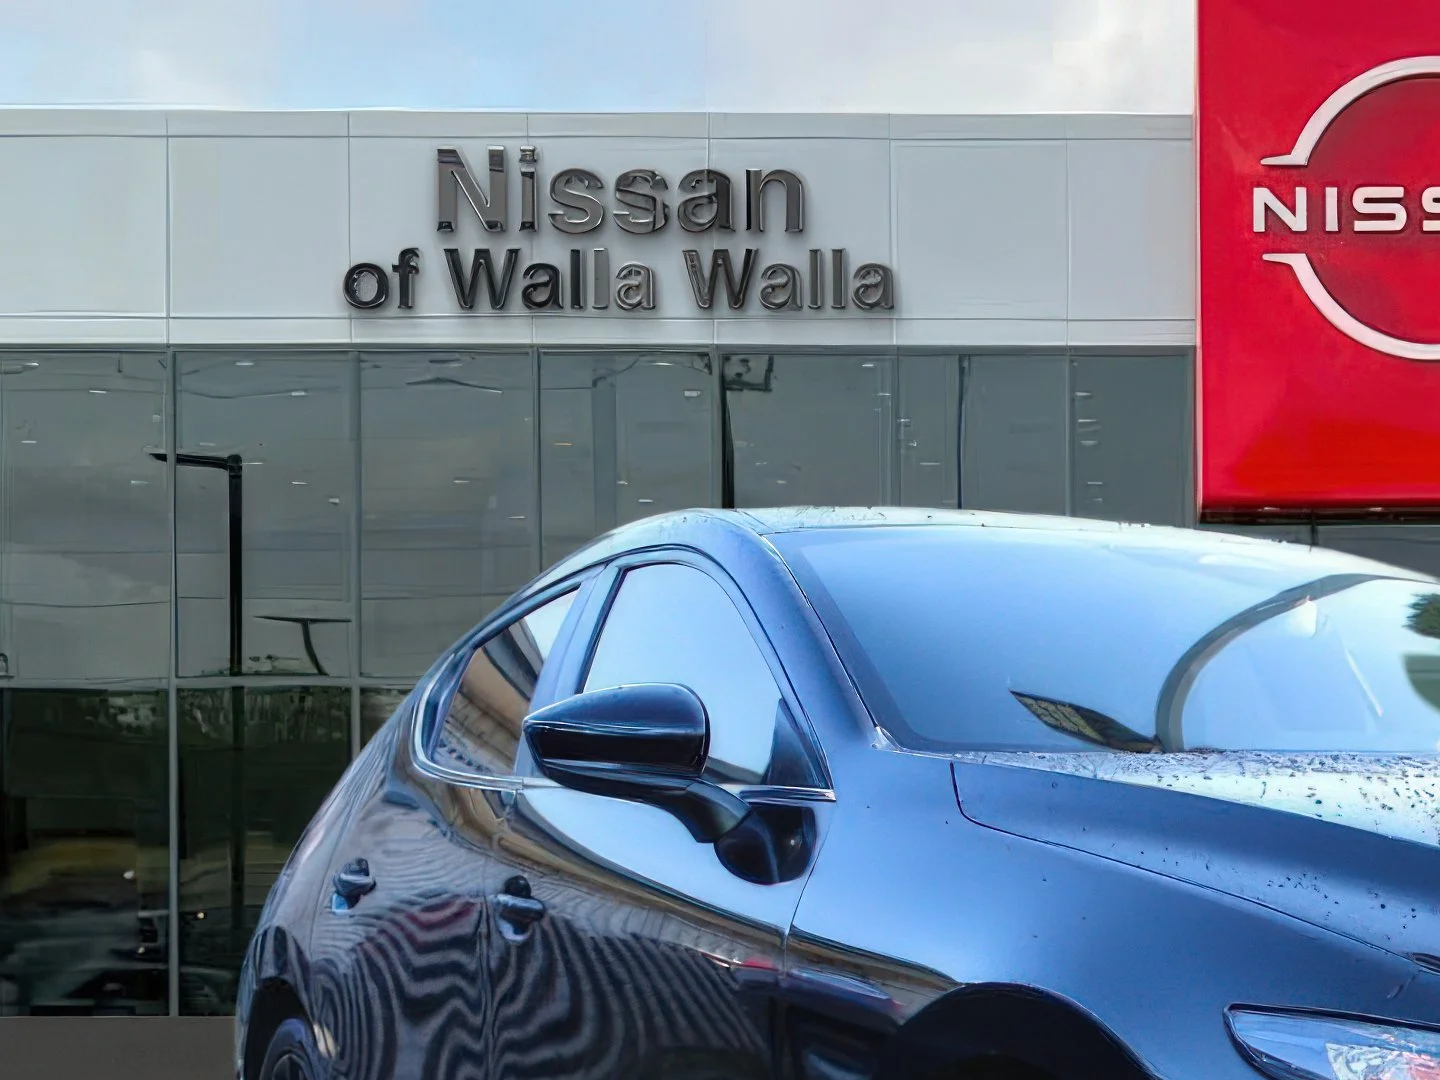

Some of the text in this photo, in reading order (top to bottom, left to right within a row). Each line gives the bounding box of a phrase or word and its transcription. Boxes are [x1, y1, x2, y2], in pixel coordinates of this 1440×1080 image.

[435, 145, 805, 234] Nissan
[342, 247, 896, 311] of Walla Walla
